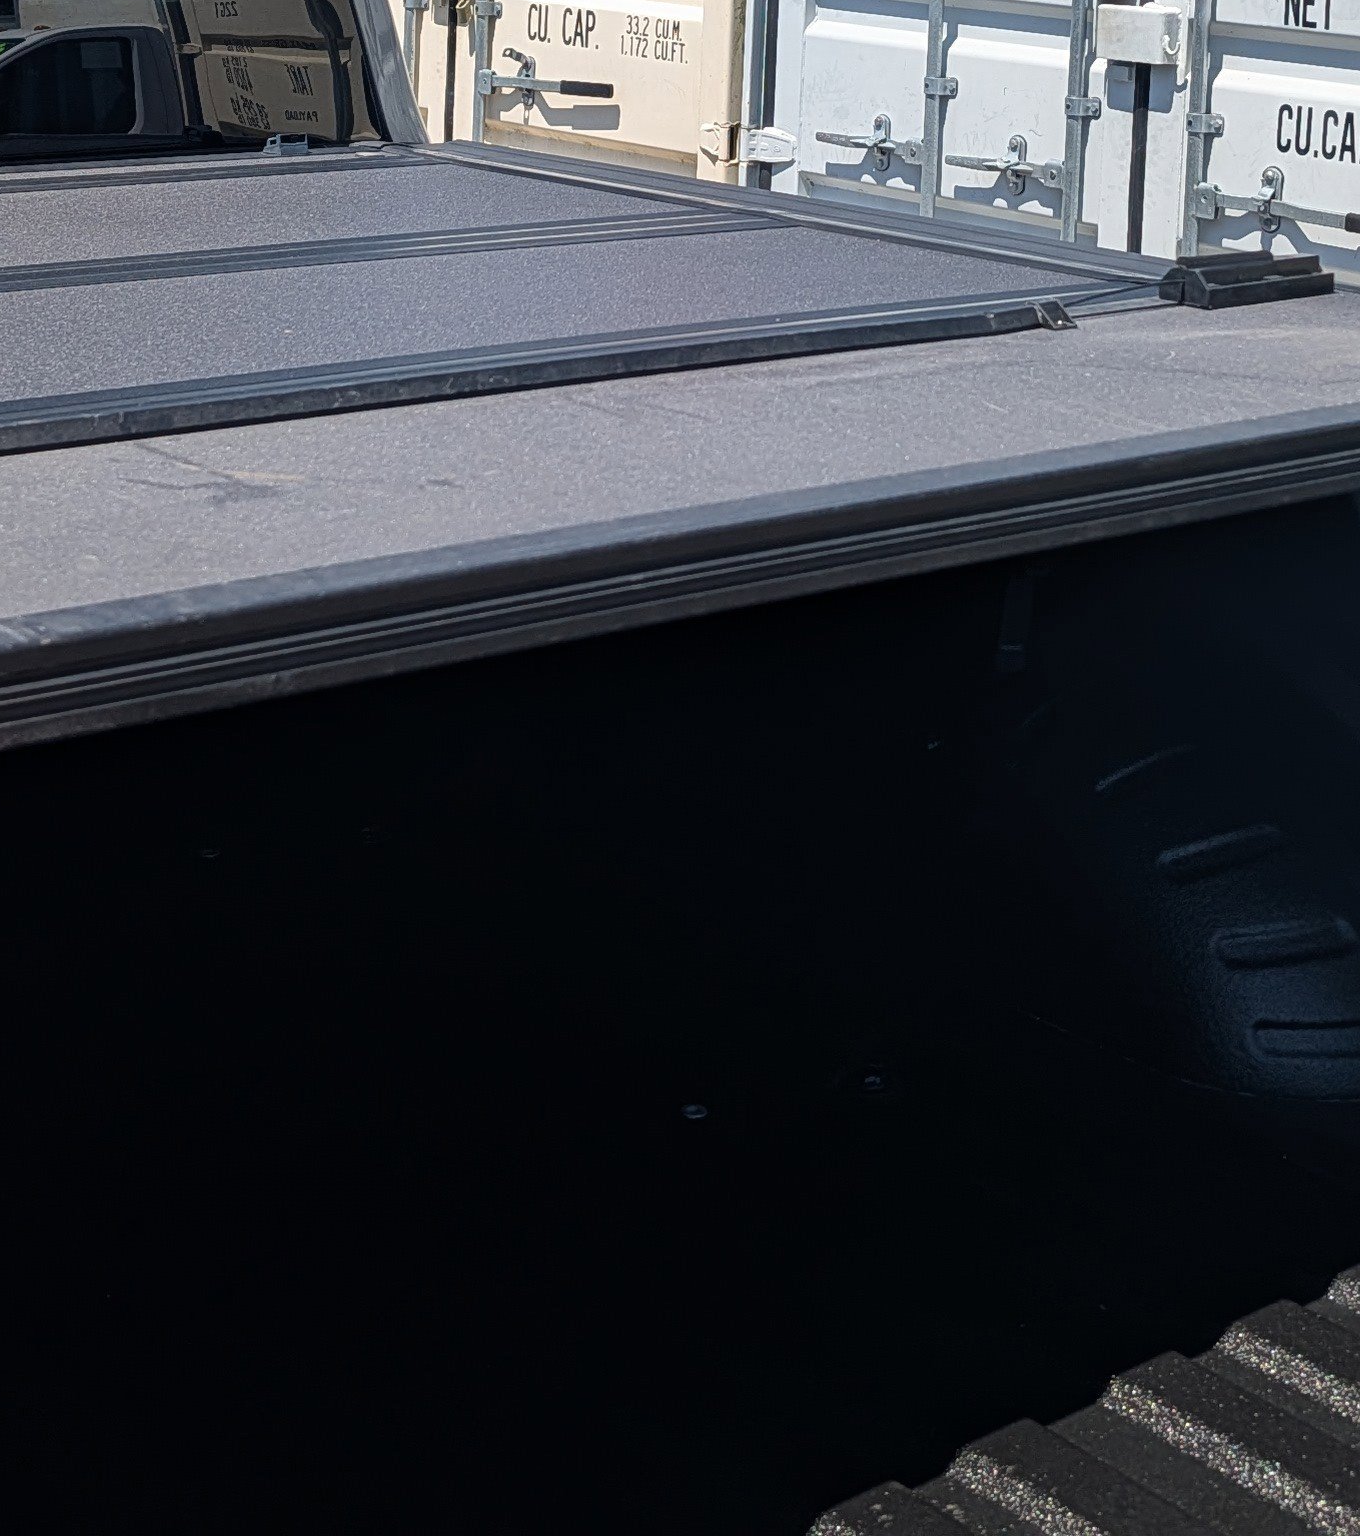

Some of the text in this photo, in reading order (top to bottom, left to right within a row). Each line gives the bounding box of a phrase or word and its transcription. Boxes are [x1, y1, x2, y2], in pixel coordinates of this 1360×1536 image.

[527, 3, 599, 50] CU. CAP.
[625, 14, 650, 38] 33.2
